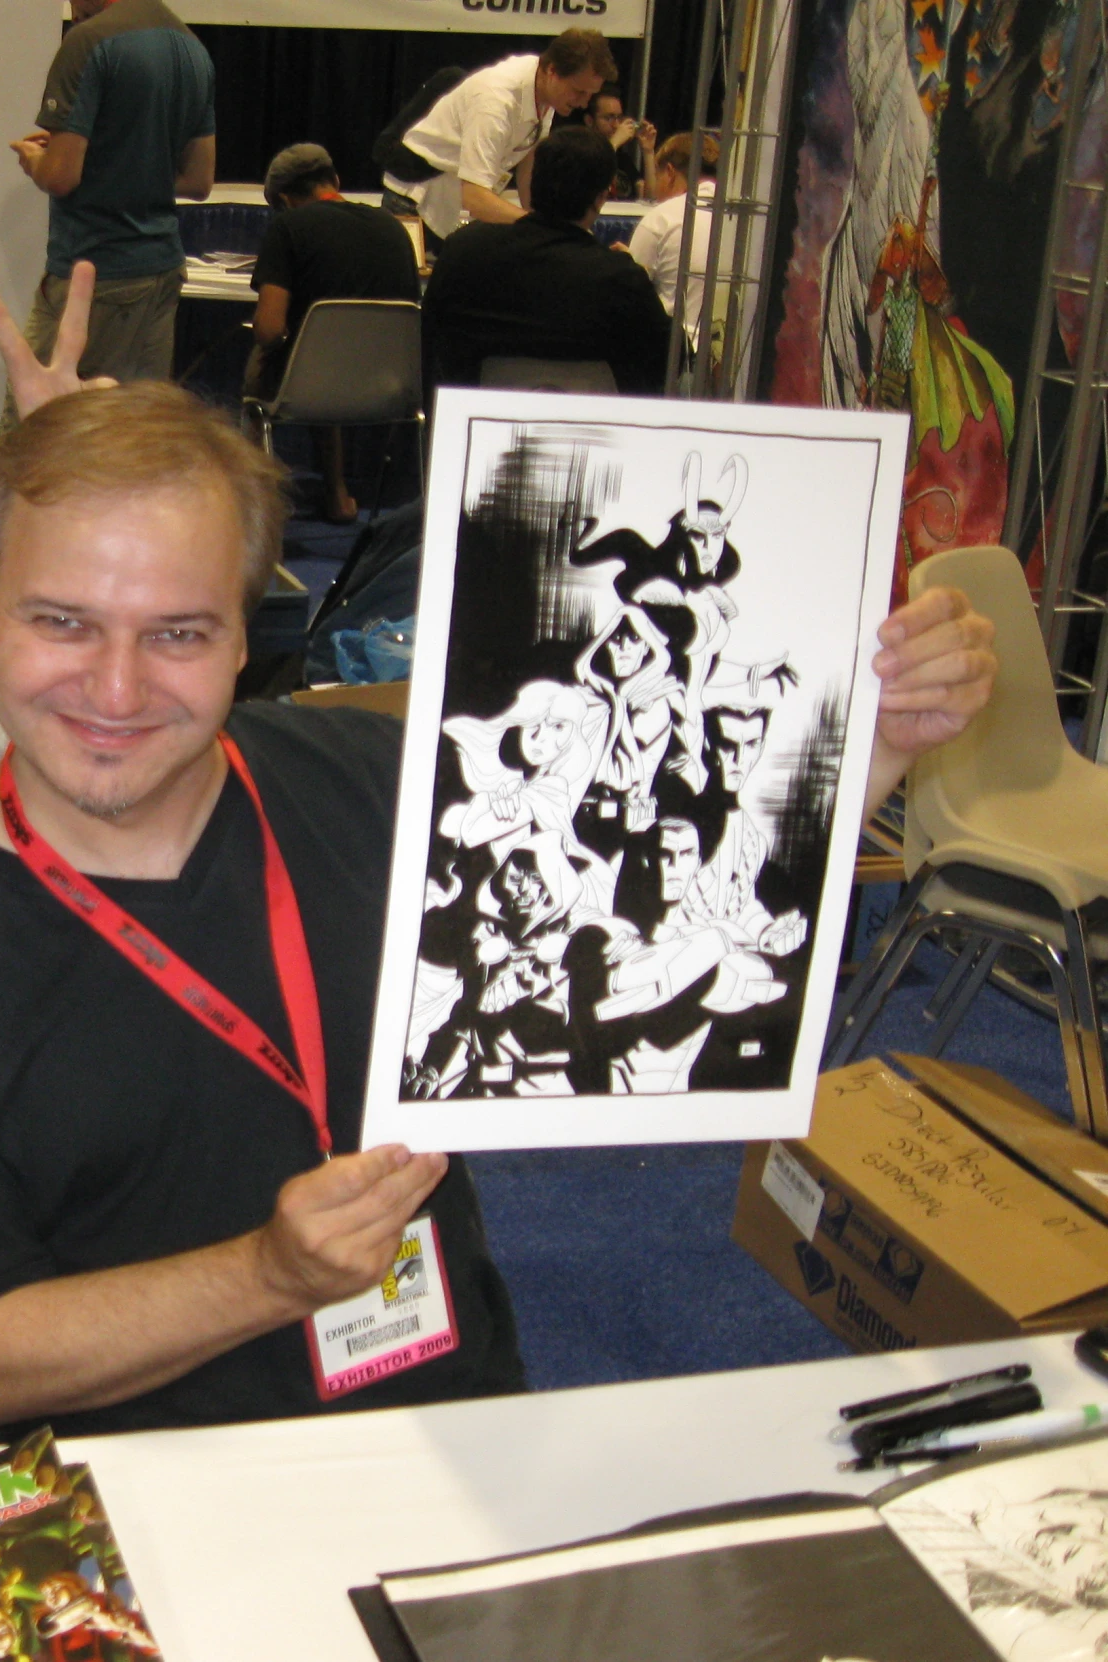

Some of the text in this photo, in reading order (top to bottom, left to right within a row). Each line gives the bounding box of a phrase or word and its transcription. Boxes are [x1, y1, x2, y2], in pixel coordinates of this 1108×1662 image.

[462, 0, 608, 16] comics
[325, 1314, 376, 1342] EXHIBITOR
[327, 1335, 452, 1393] EXHIBITOR 2009
